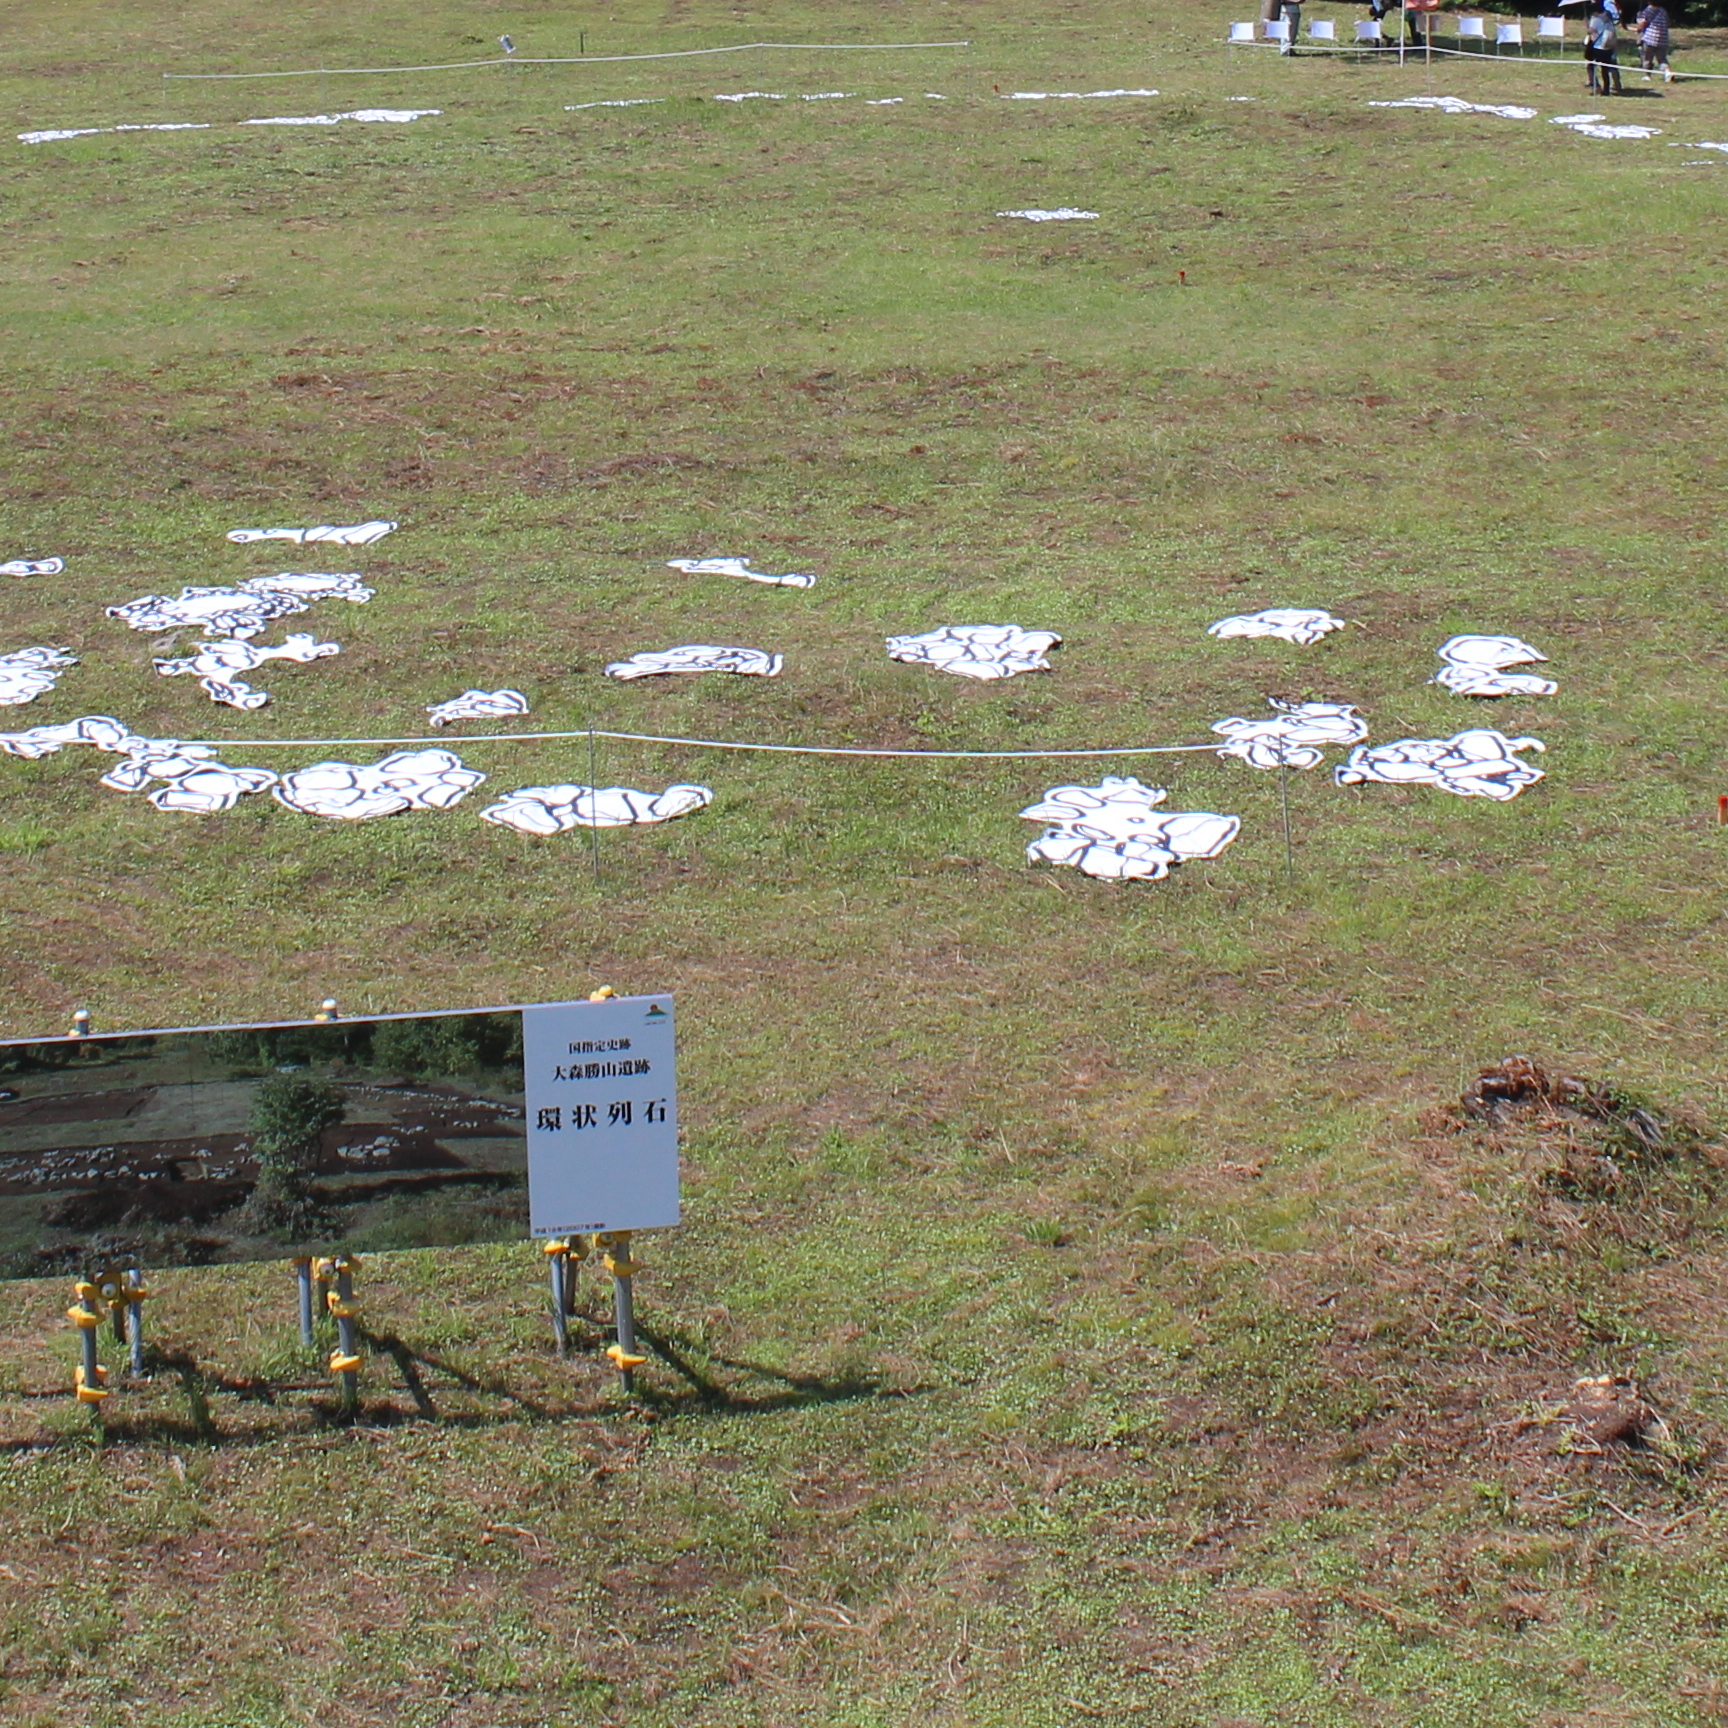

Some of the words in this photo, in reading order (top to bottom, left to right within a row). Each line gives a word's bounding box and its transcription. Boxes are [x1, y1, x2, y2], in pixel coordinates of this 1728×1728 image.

[568, 1038, 632, 1055] 国指定史跡
[552, 1059, 651, 1082] 大森勝山遺跡
[536, 1098, 668, 1132] 環状列石
